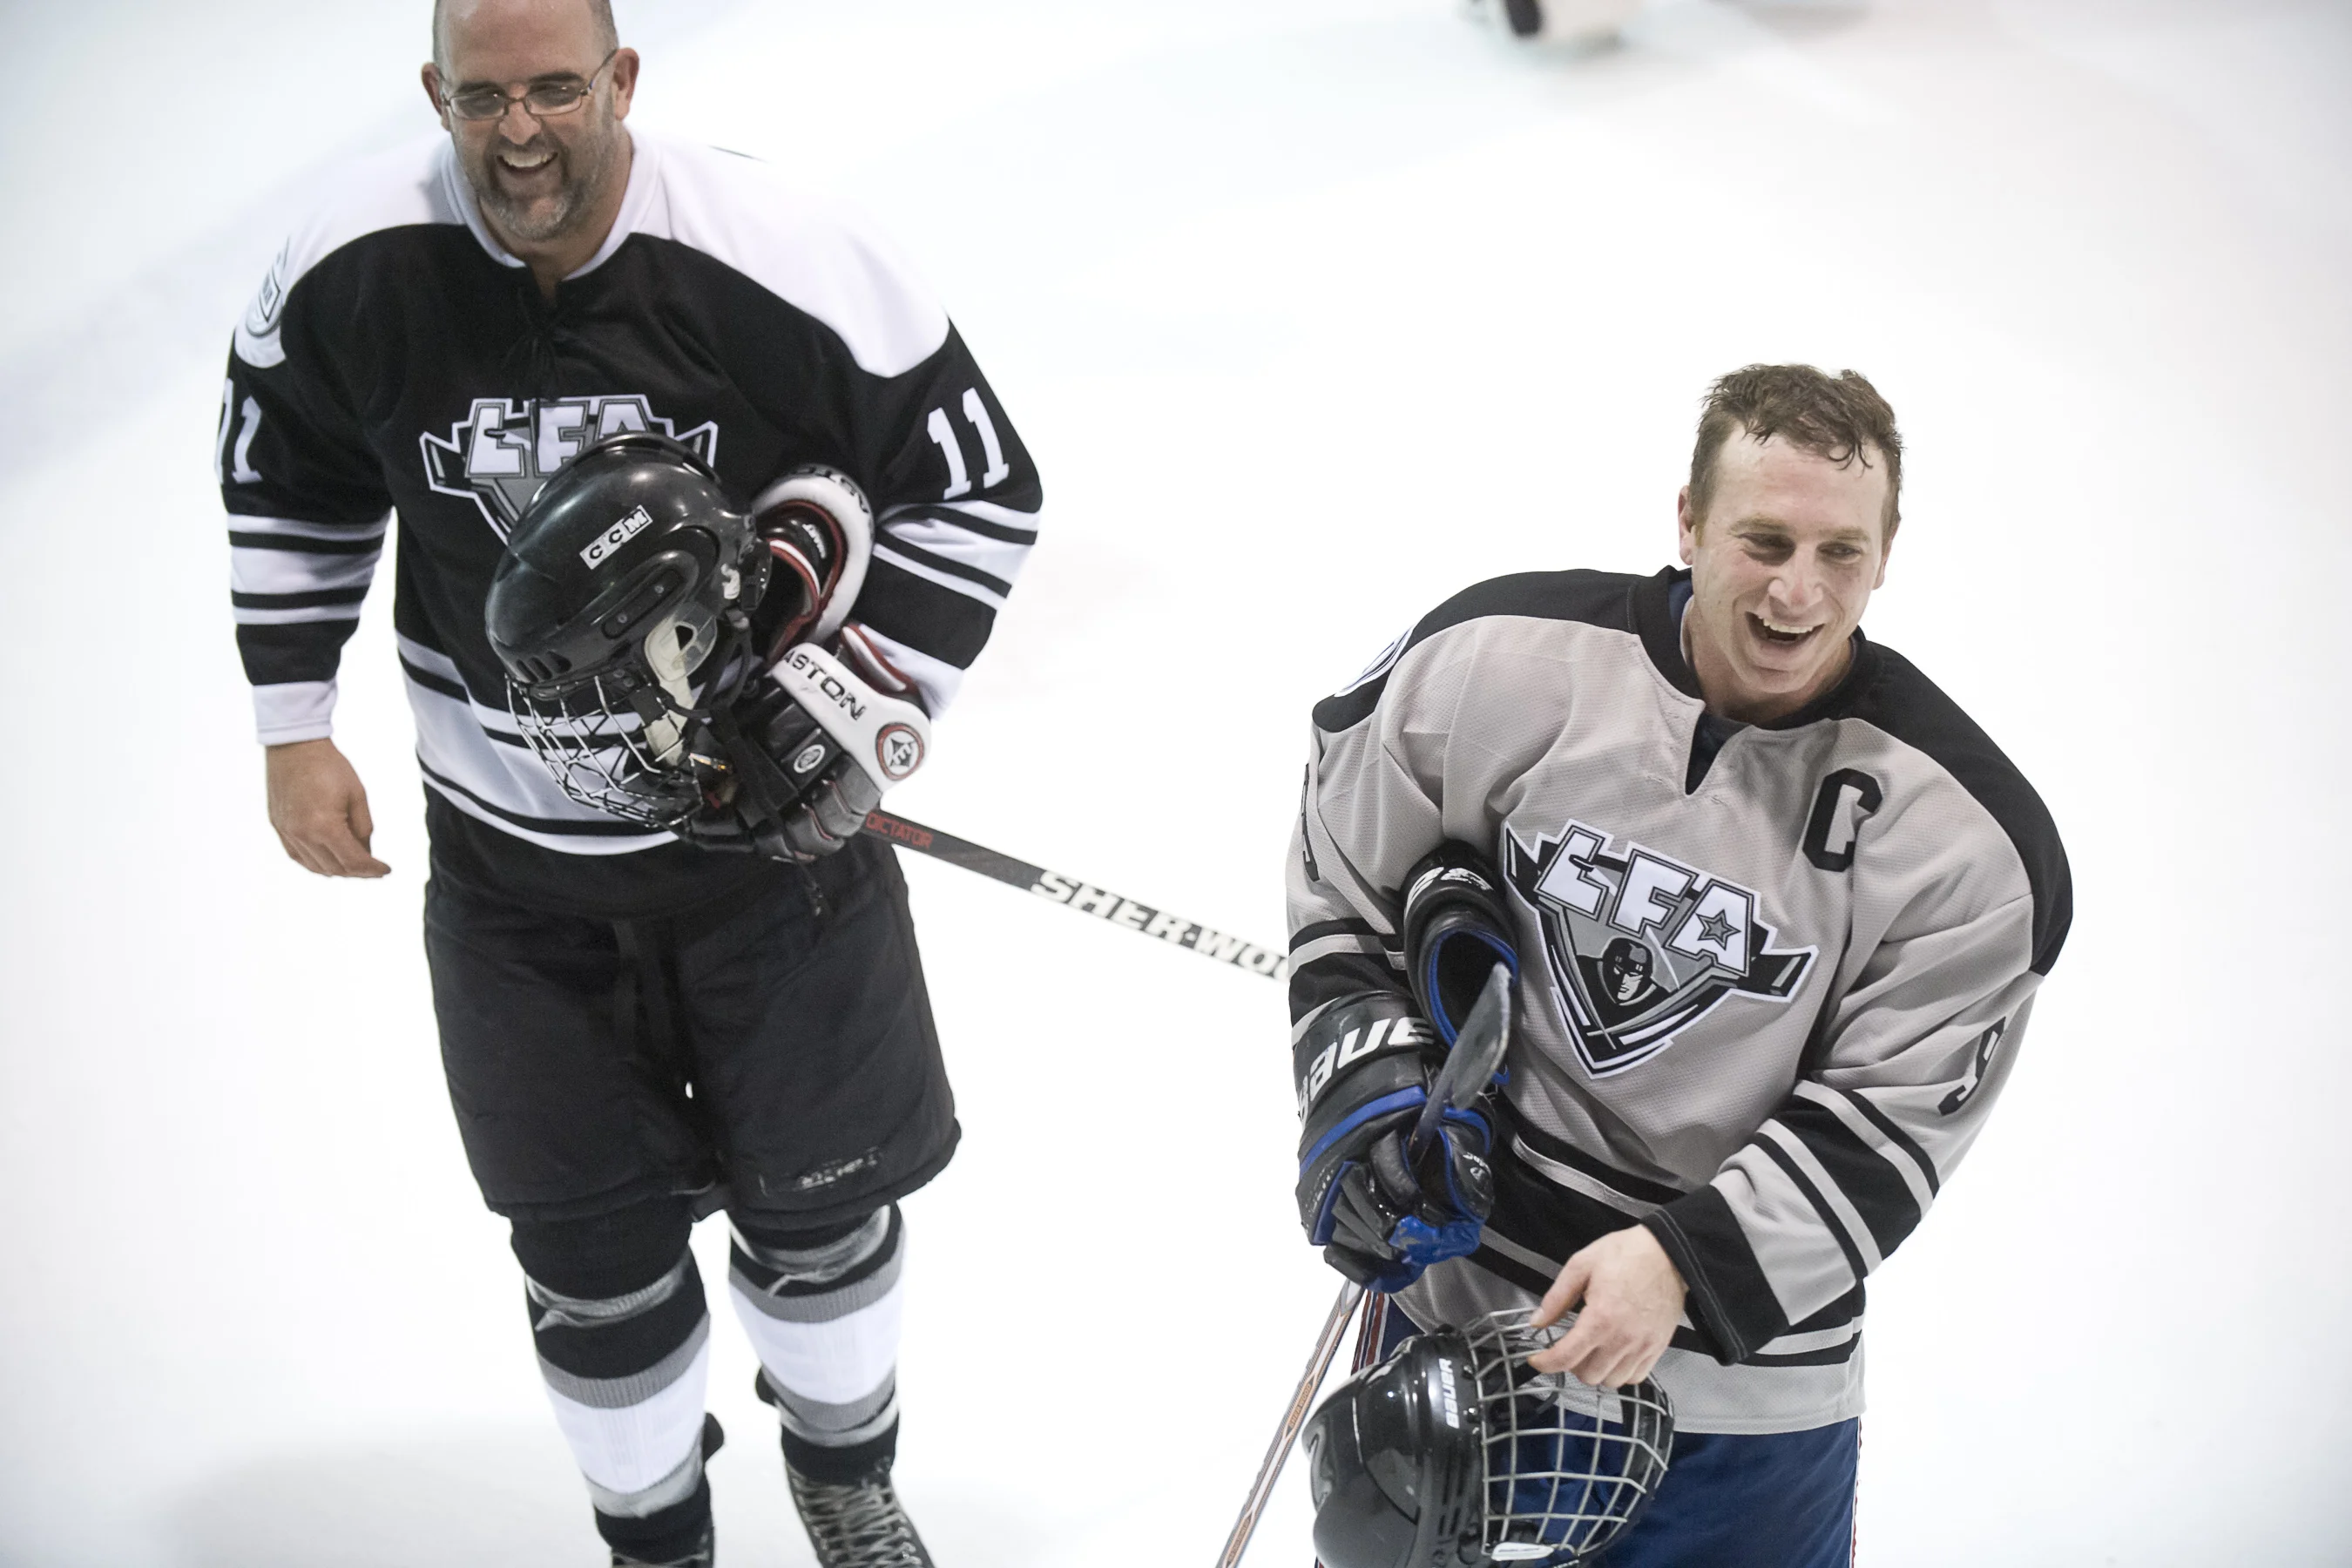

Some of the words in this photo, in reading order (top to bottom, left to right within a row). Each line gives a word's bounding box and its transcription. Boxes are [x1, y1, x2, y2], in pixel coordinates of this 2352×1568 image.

[928, 388, 1010, 500] 11
[589, 510, 647, 560] CCM
[865, 811, 933, 850] DICTATOR
[1802, 767, 1882, 872] C
[1438, 1358, 1460, 1429] BAUER
